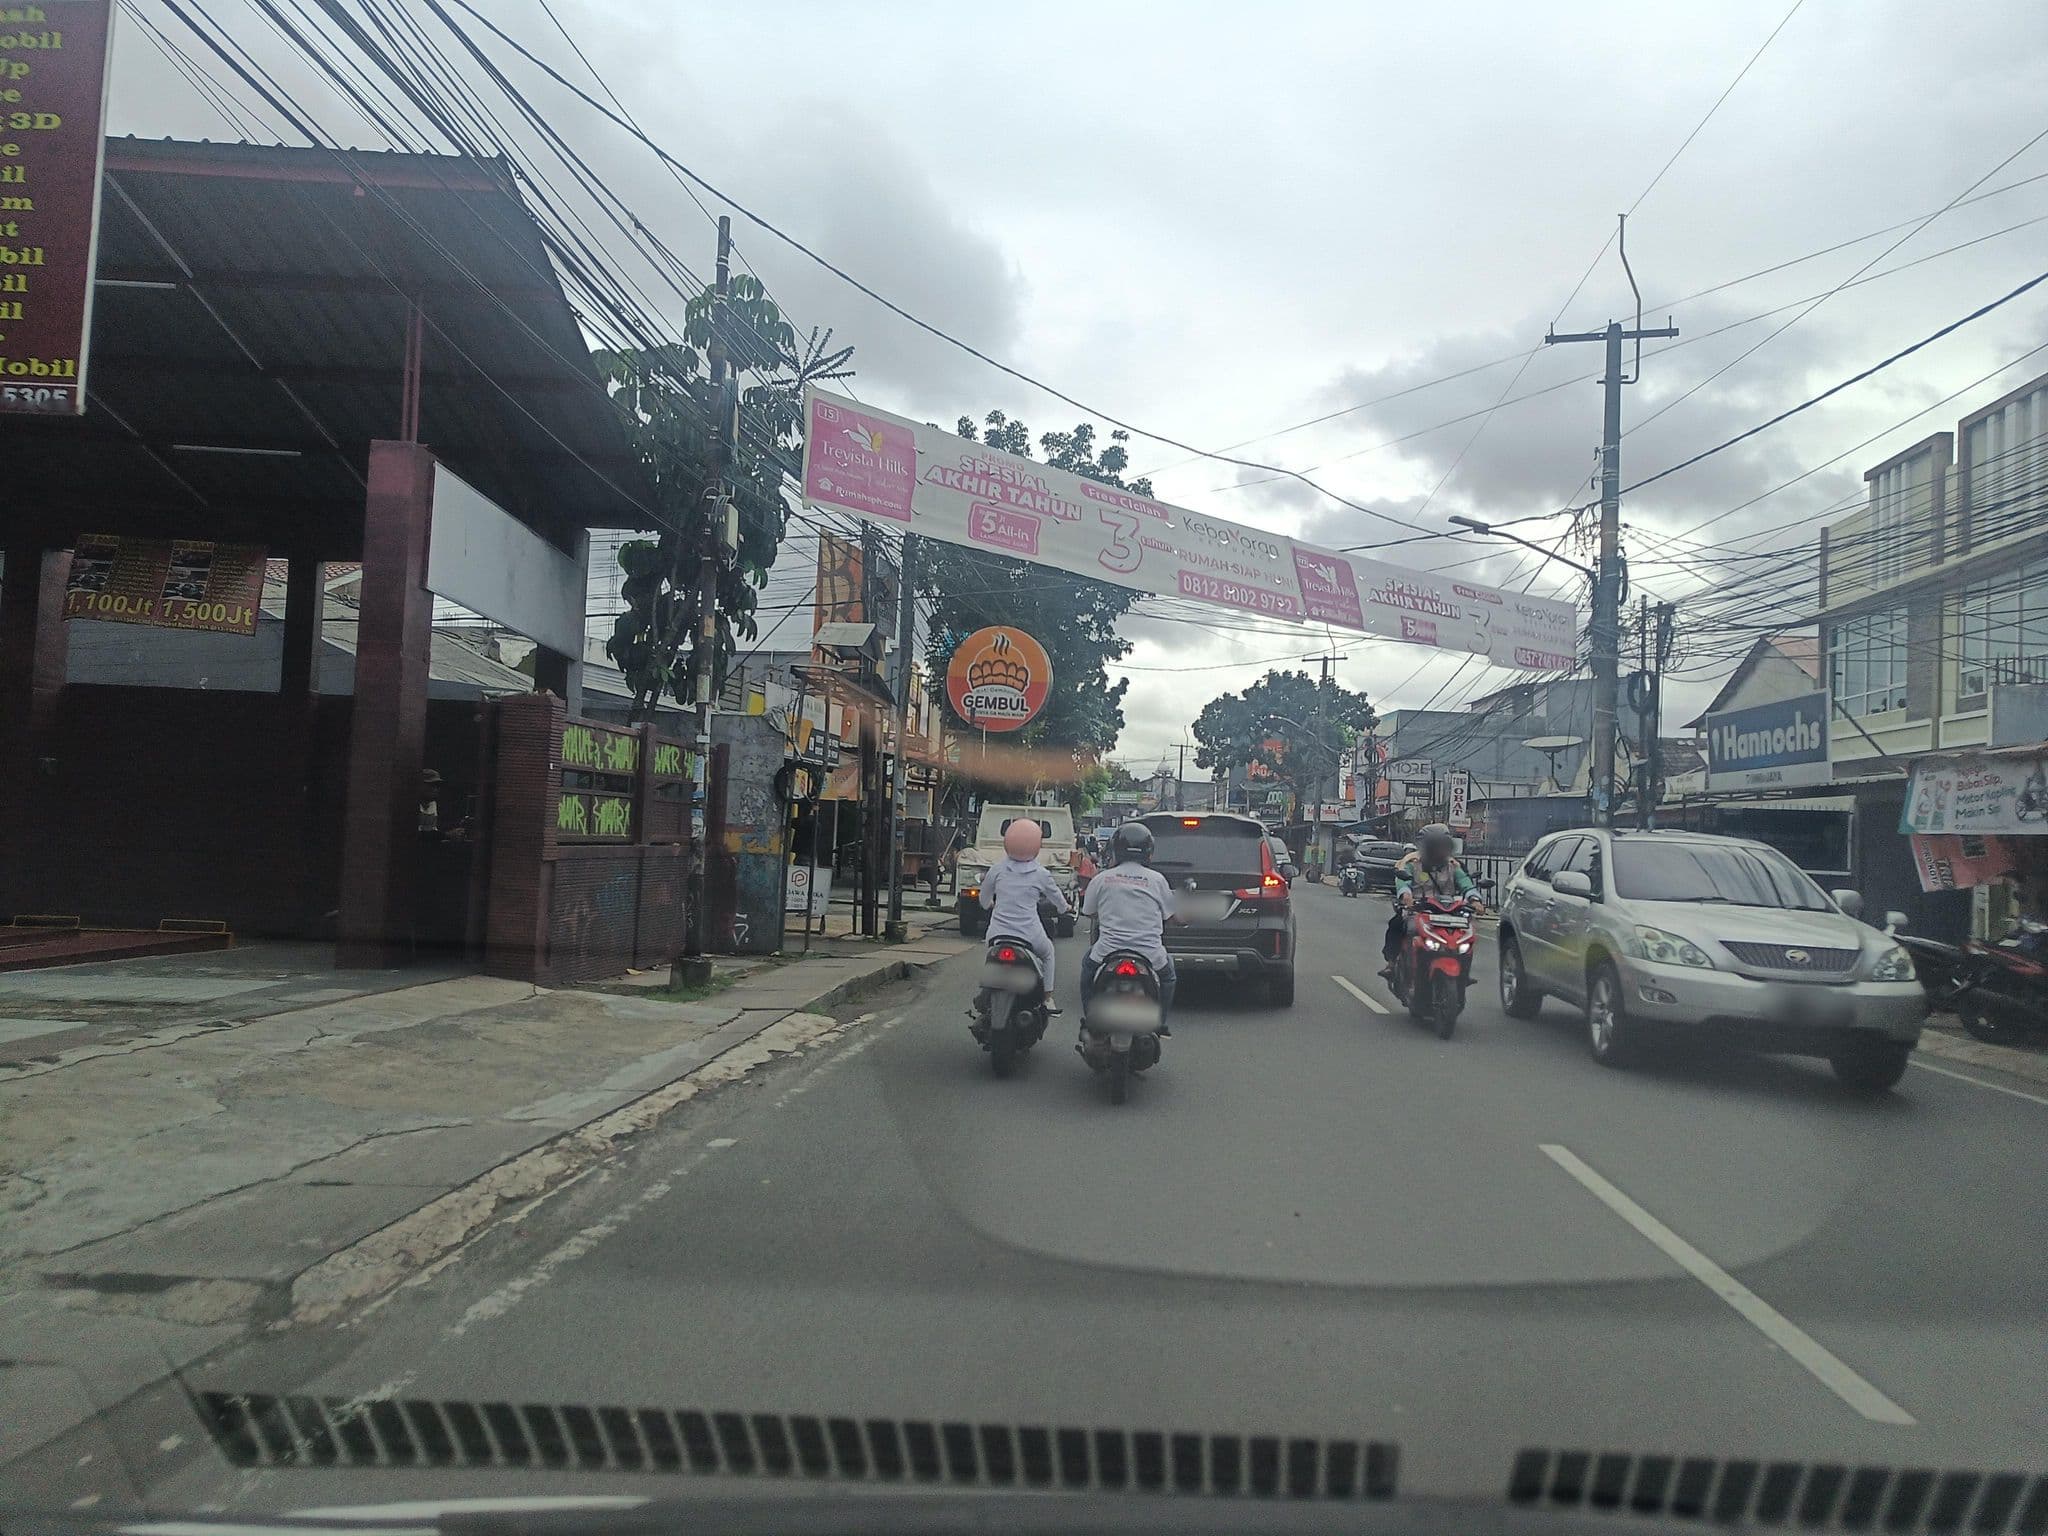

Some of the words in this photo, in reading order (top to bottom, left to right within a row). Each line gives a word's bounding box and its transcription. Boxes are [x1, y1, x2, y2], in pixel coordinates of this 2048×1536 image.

[878, 456, 909, 477] Hills
[960, 455, 1050, 495] SPESIAL
[926, 465, 1001, 500] AKHIR
[1007, 486, 1083, 521] TAHUN
[1087, 486, 1118, 505] Free
[1119, 496, 1162, 519] Cicilan
[1098, 507, 1143, 573] 3
[1179, 548, 1229, 572] RUMAH
[1230, 562, 1261, 579] SIAP
[1182, 574, 1219, 599] 0812
[163, 601, 254, 626] 1,500Jt
[1370, 588, 1414, 609] AKHIR
[1414, 598, 1462, 619] TAHUN
[963, 695, 1029, 713] GEMBUL
[1722, 711, 1820, 761] Hannochs
[1453, 787, 1465, 816] OBAT
